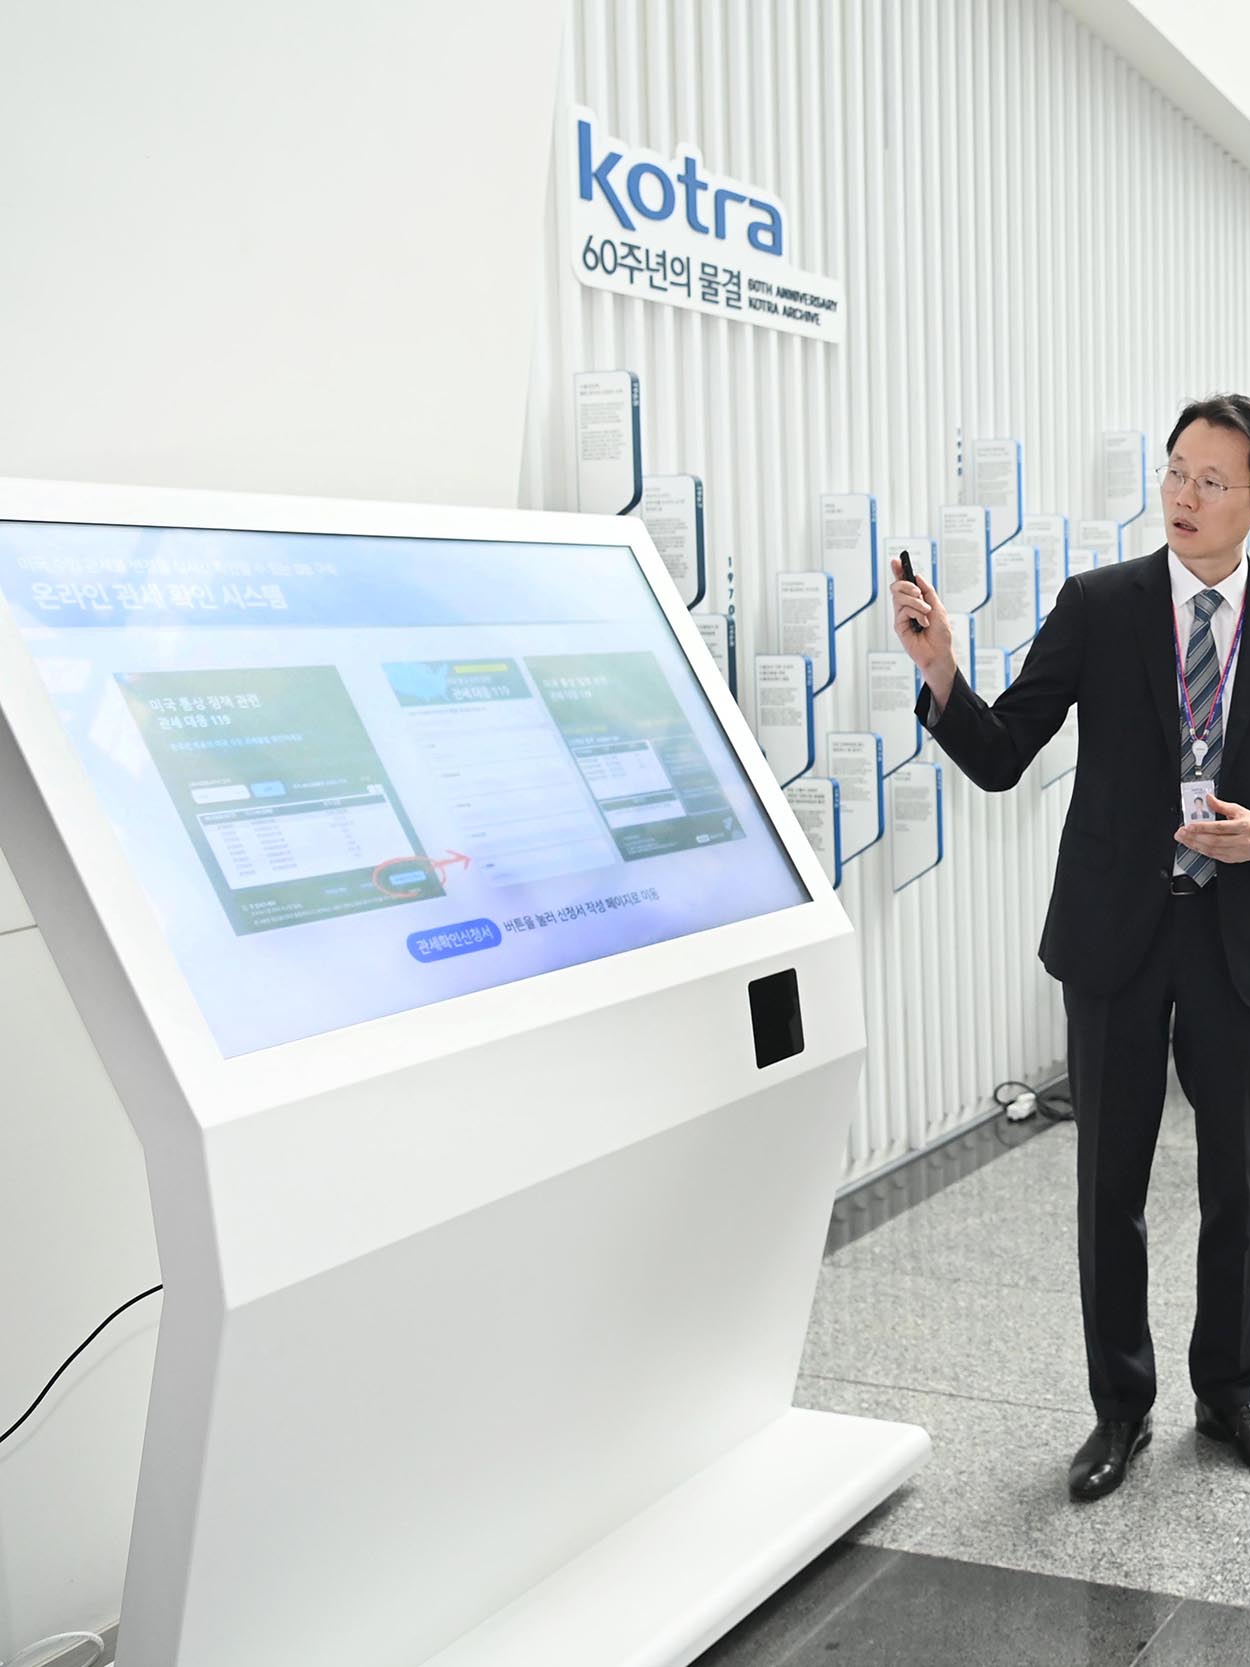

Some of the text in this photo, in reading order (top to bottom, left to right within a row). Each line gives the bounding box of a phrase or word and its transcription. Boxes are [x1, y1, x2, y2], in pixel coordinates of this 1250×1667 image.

[578, 119, 783, 257] kotra
[582, 235, 743, 311] 60주년의 물결
[747, 277, 838, 313] 60TH ANNIVERSARY
[747, 295, 822, 327] KOTRA ARCHIVE
[32, 582, 113, 610] 온라인
[221, 583, 289, 610] 시스템
[727, 555, 736, 616] 1970
[151, 698, 177, 712] 미국
[415, 925, 495, 955] 관세확인신청서
[503, 917, 536, 933] 버튼을
[536, 912, 557, 928] 눌러
[557, 903, 586, 923] 신청서
[586, 899, 606, 916] 작성
[641, 886, 660, 902] 이동
